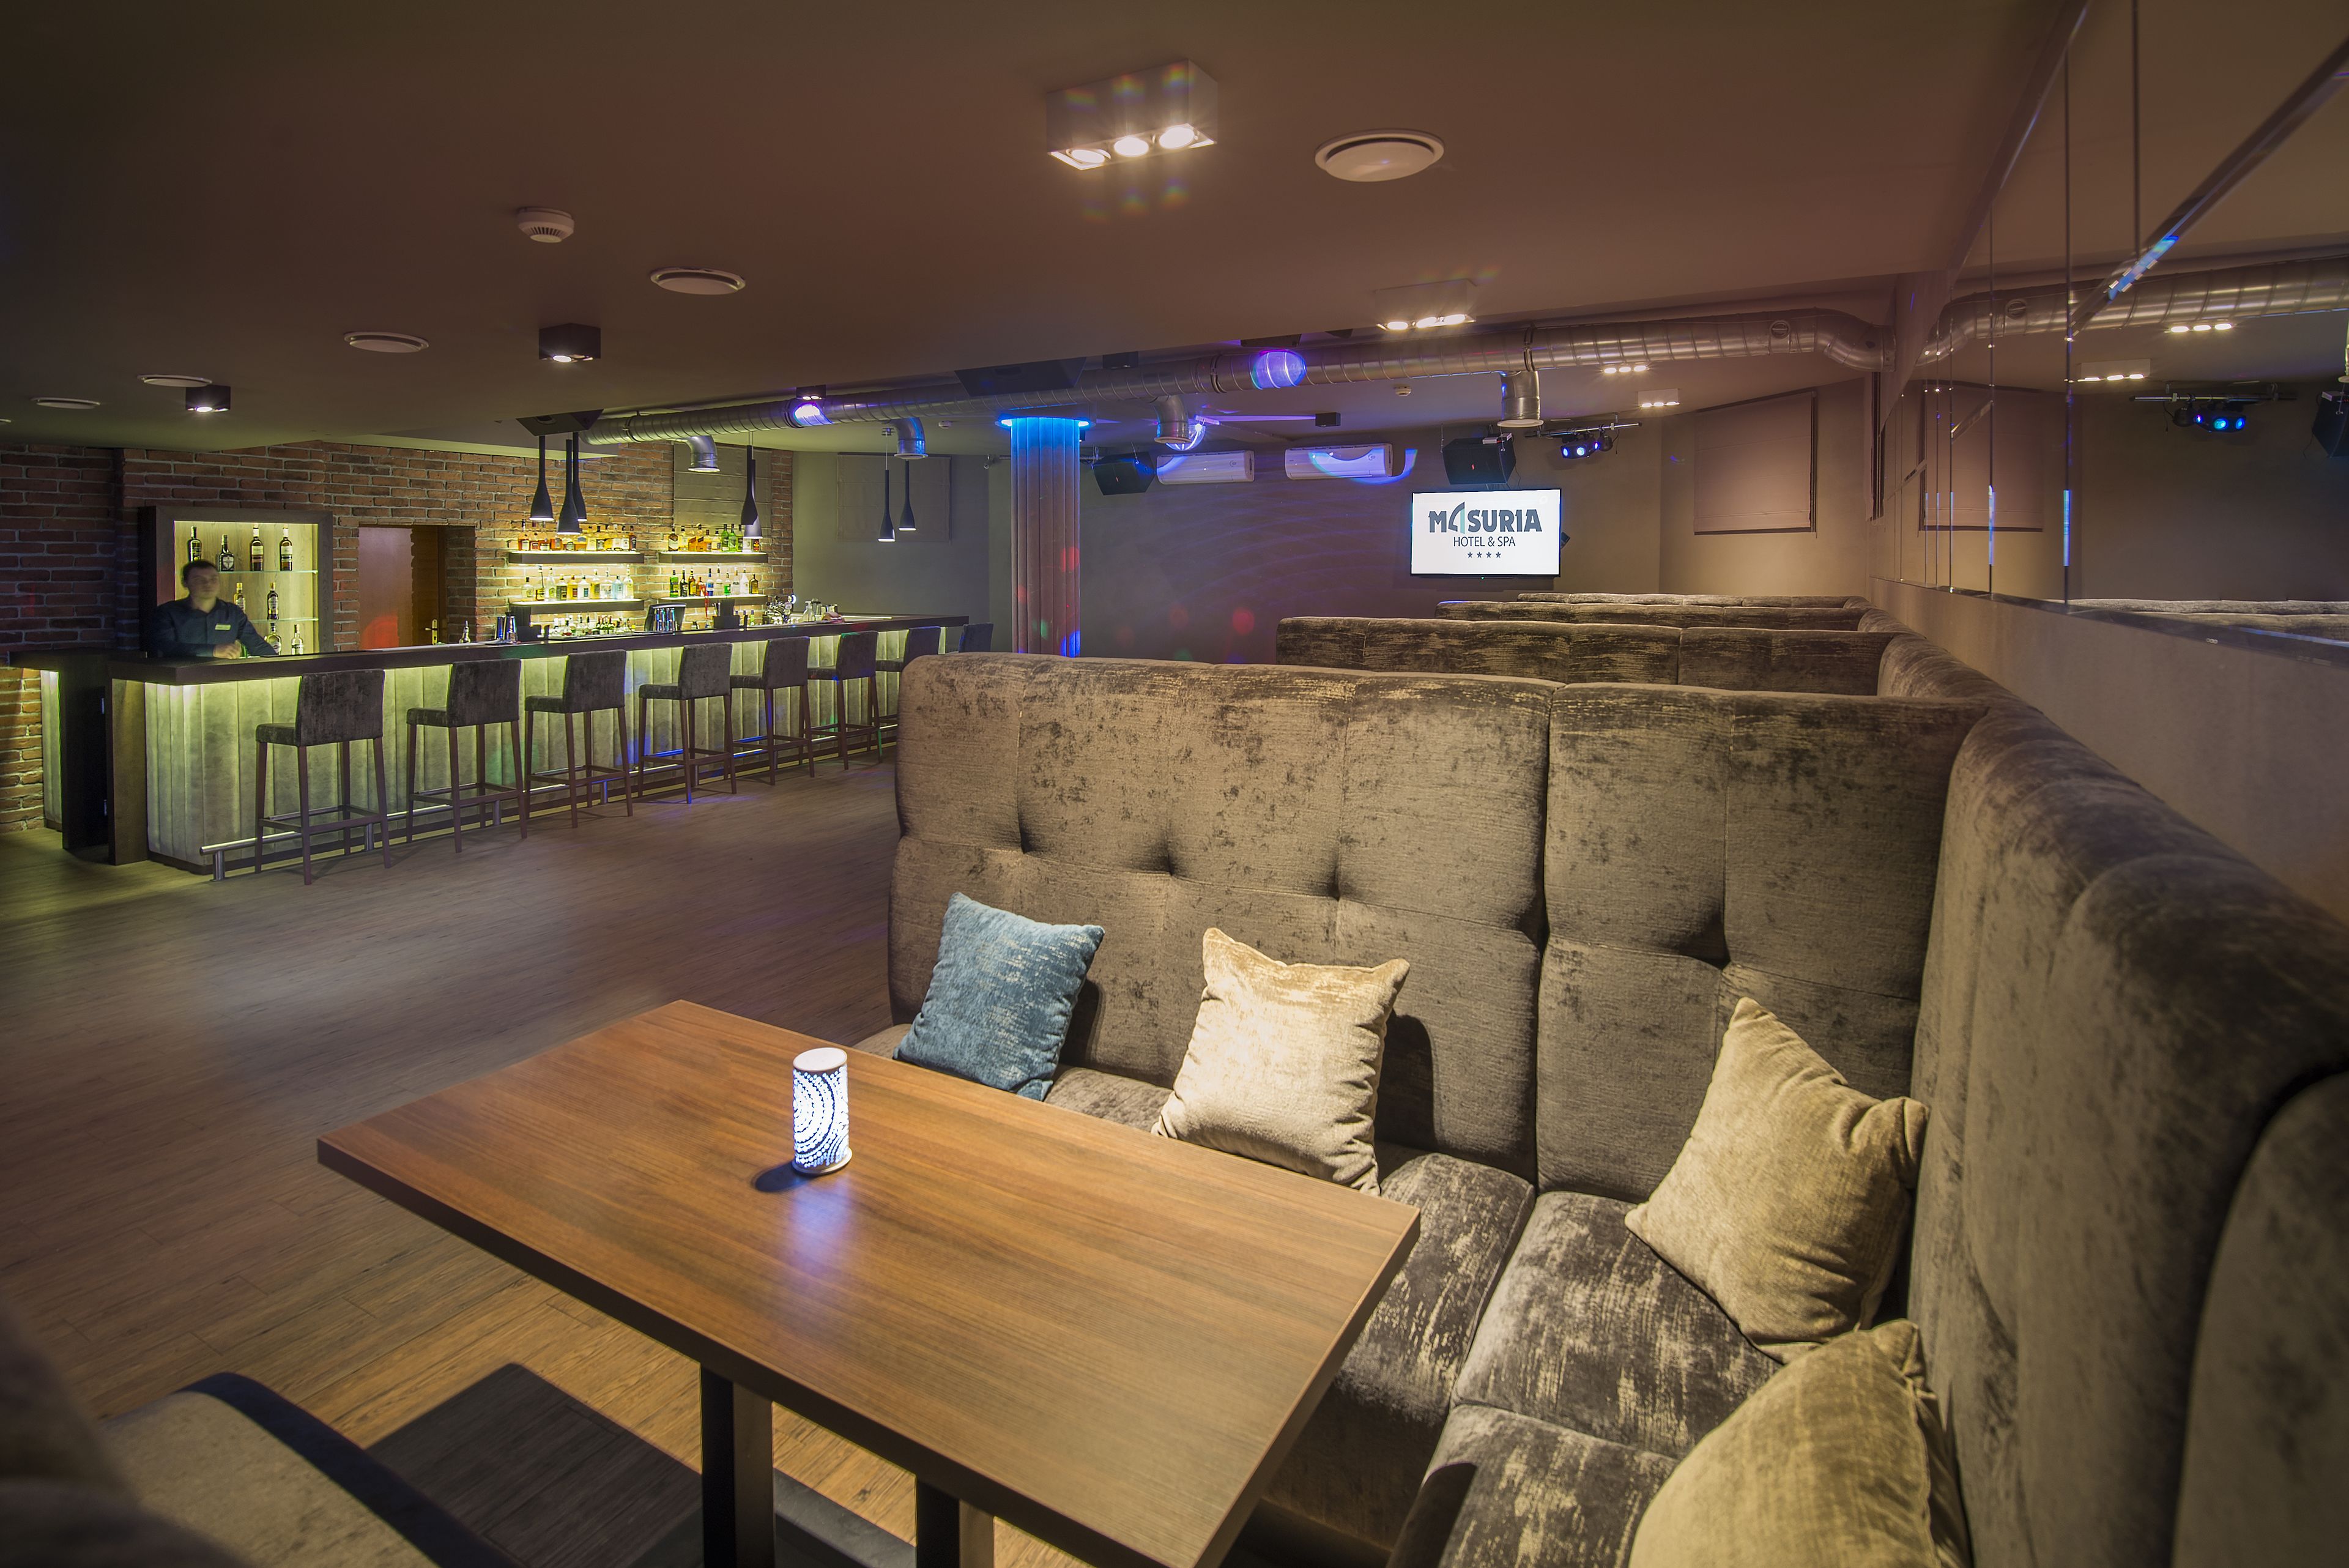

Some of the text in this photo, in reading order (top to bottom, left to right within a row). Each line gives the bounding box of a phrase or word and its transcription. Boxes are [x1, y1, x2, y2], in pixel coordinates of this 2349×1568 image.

[1428, 502, 1542, 534] MASURIA
[1453, 536, 1516, 547] HOTEL & SPA
